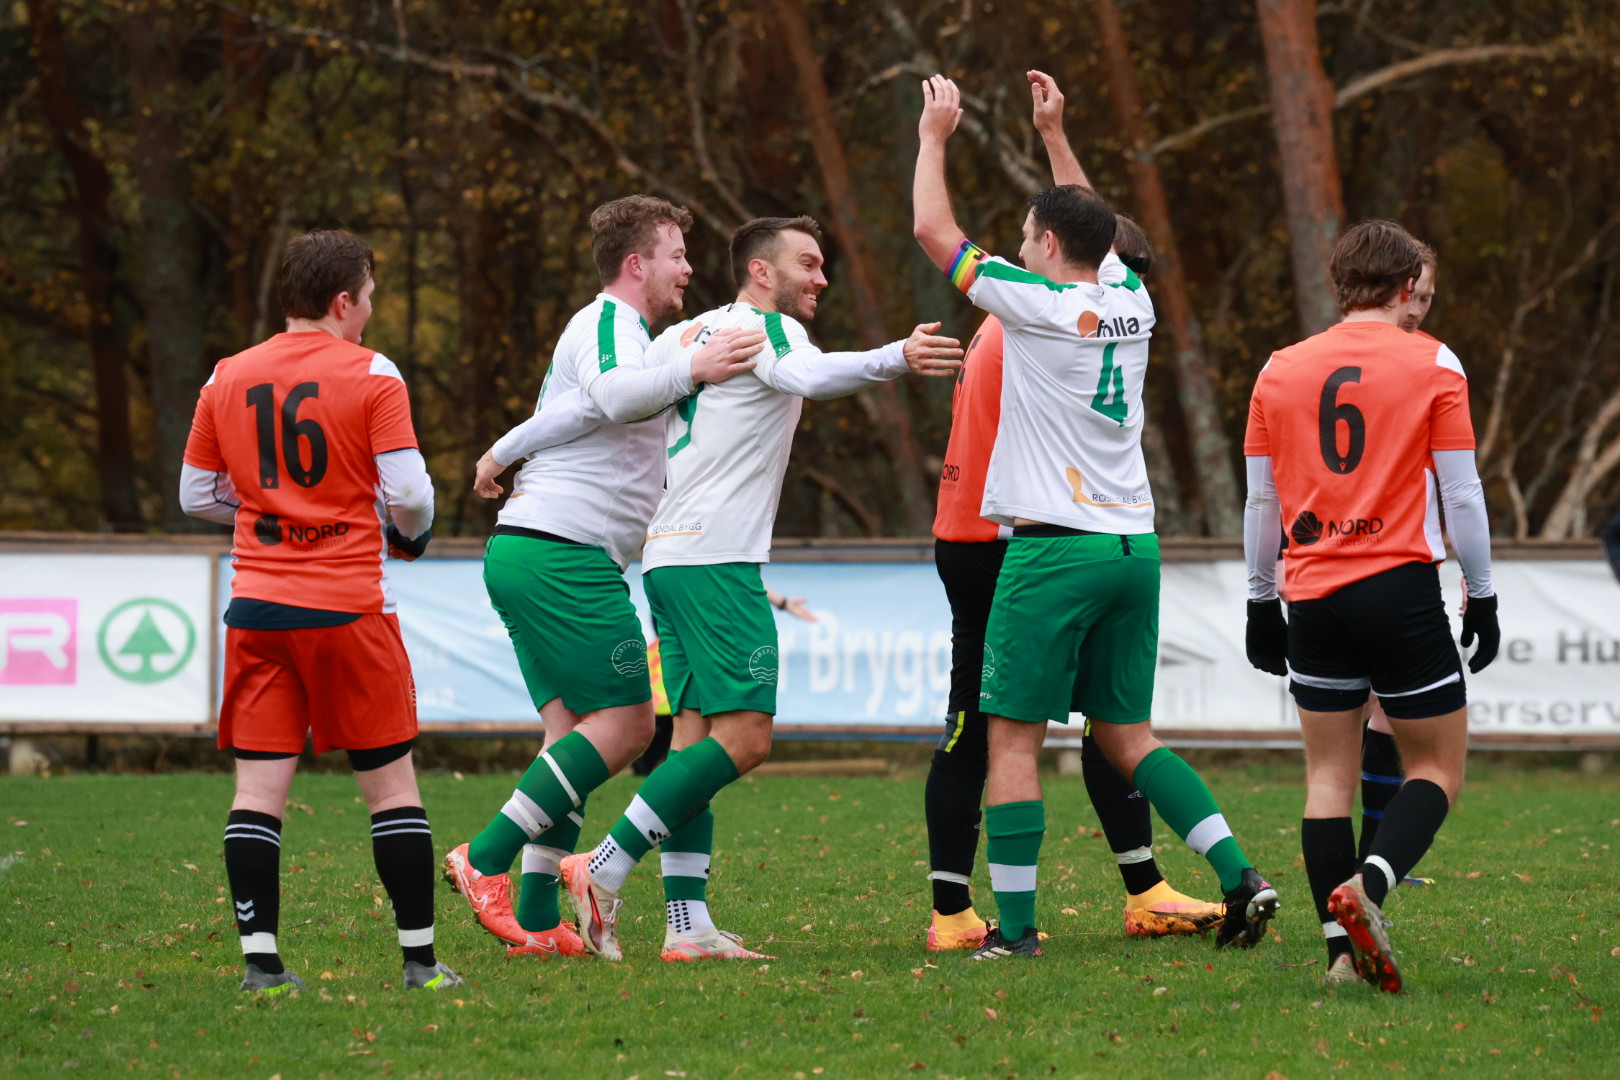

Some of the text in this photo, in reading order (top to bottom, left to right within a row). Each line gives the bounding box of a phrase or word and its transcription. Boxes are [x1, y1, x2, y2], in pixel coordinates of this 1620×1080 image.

[1096, 316, 1140, 338] folla
[1090, 342, 1128, 428] 4
[246, 381, 328, 489] 16
[1319, 366, 1366, 475] 6
[288, 522, 349, 542] NORD
[1328, 517, 1384, 538] NORD
